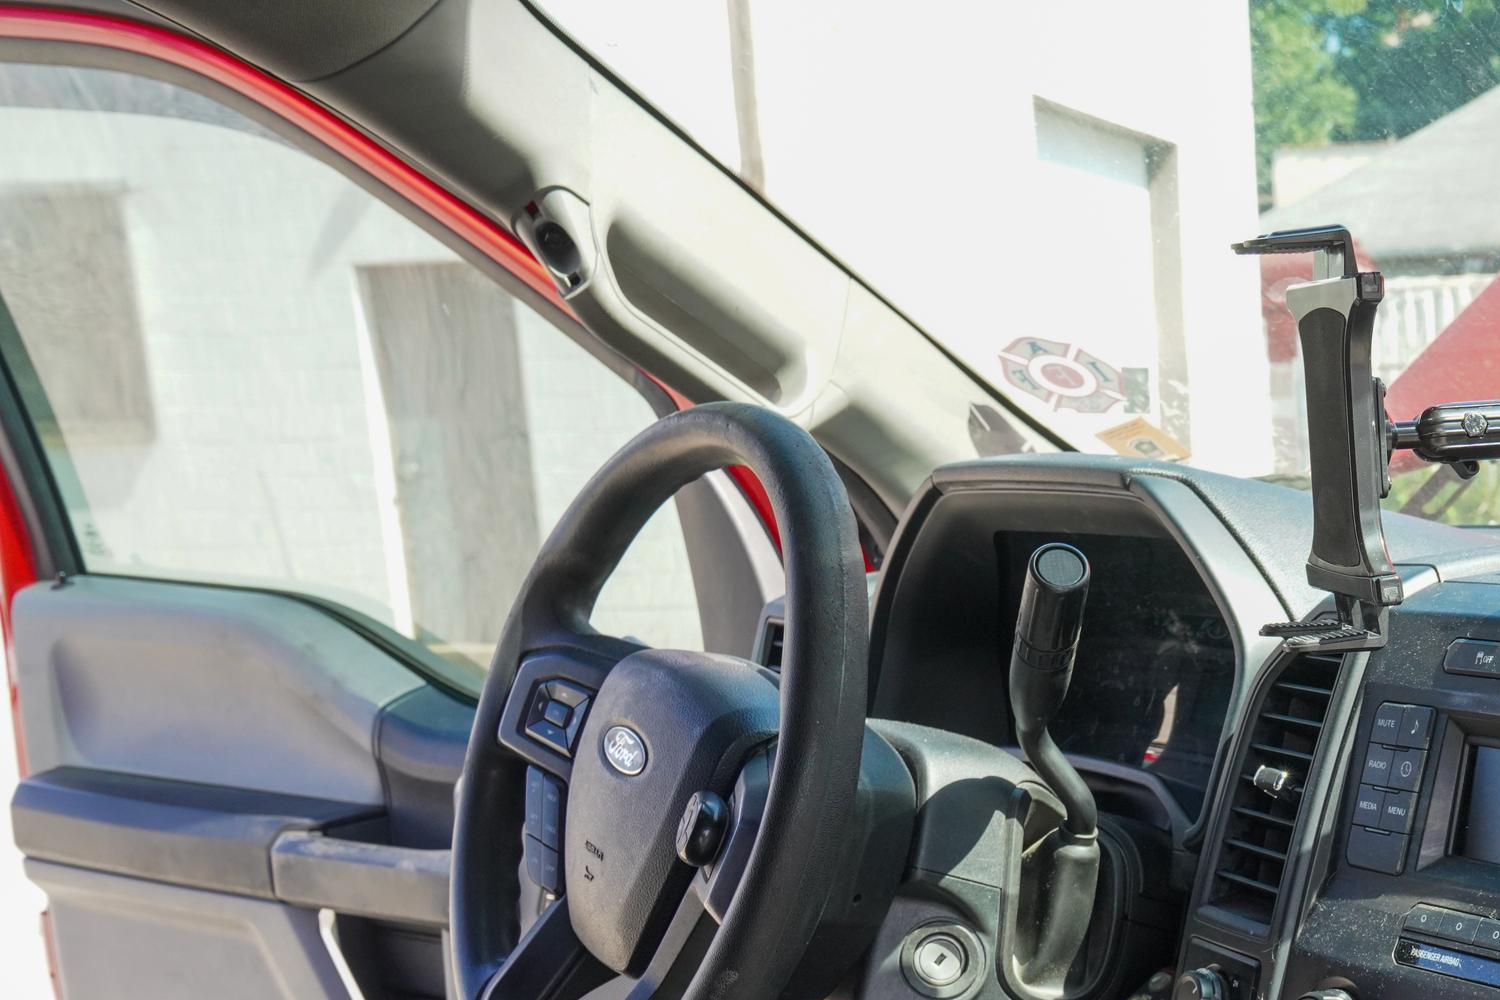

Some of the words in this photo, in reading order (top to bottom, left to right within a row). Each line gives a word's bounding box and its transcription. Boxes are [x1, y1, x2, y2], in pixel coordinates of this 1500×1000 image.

[1377, 718, 1396, 728] MUTE
[608, 731, 639, 767] Ford
[1368, 759, 1387, 770] RADIO
[1359, 800, 1377, 811] MEDIA
[1387, 806, 1406, 816] MENU
[1410, 947, 1440, 961] PASSENGER
[1440, 955, 1459, 967] AIRBAG
